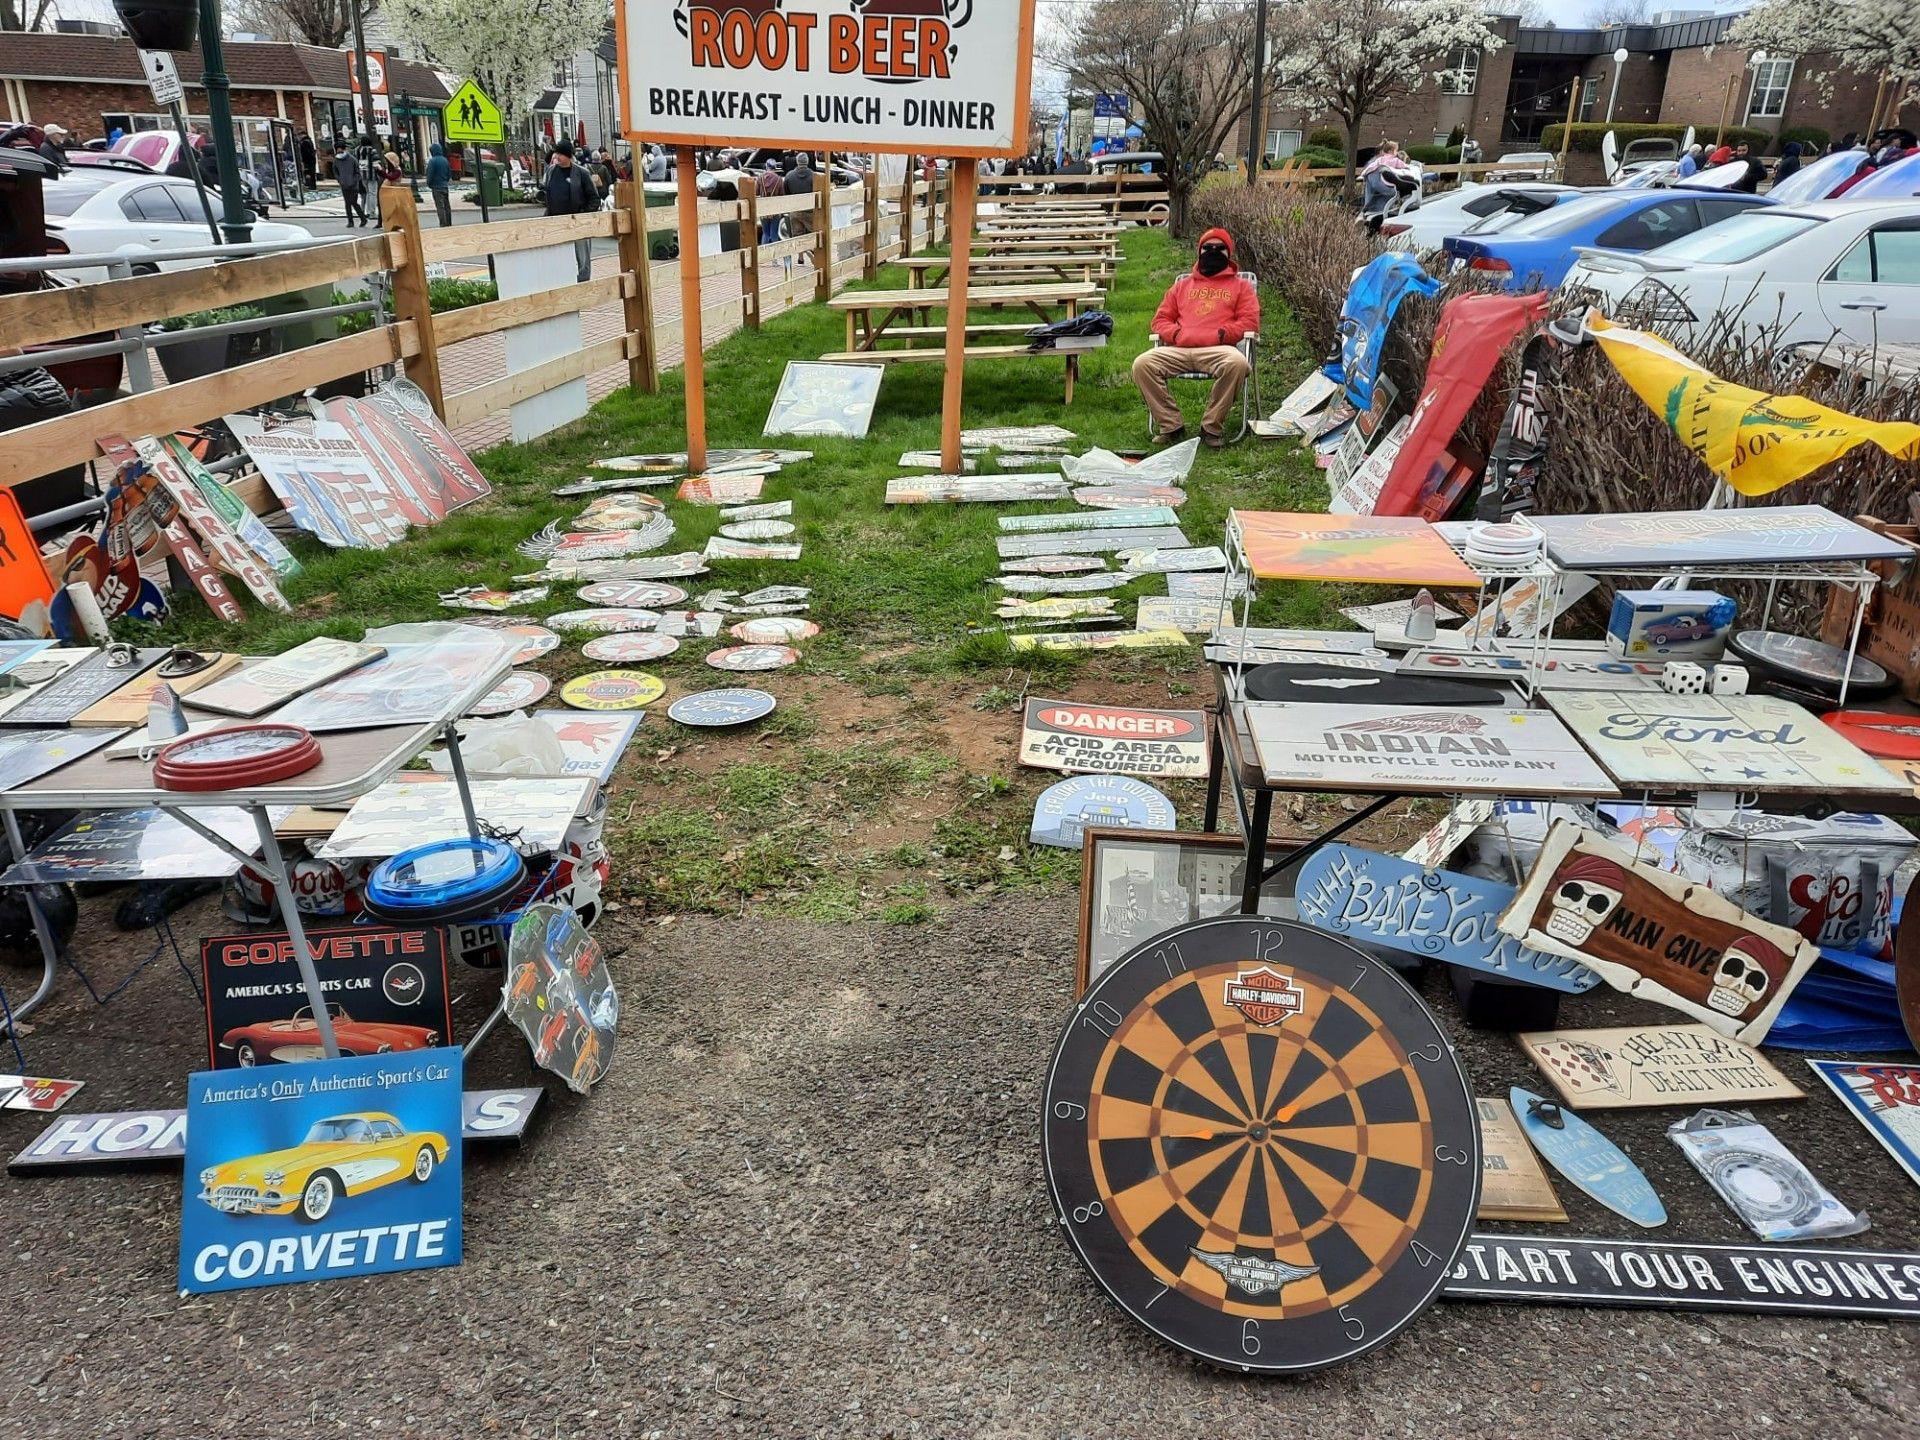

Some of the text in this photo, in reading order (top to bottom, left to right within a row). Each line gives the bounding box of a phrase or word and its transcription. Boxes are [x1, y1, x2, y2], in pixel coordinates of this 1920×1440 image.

[689, 7, 951, 79] ROOT BEER
[649, 87, 996, 130] BREAKFAST LUNCH DINNER
[244, 435, 357, 450] AMERICA'S BEER
[590, 583, 672, 601] STP
[1226, 650, 1382, 669] SPEED SHOP
[589, 672, 652, 683] WE USE
[581, 699, 638, 708] PARTS
[715, 715, 741, 723] LAST
[1054, 710, 1175, 734] DANGER
[1600, 713, 1805, 745] Ford
[1029, 744, 1200, 764] EYE PROTECTION
[1045, 735, 1182, 754] ACID AREA
[1323, 732, 1511, 756] INDIAN
[1063, 757, 1164, 772] REQUIRED
[1295, 752, 1557, 771] MOTORCYCLE COMPANY
[1642, 746, 1822, 764] PARTS
[1371, 771, 1457, 783] Established
[1044, 777, 1168, 827] EXPLORE THE OUTDOORS
[1084, 792, 1129, 805] Jeep
[47, 843, 128, 852] TRUCKS
[1250, 929, 1284, 962] 12
[1606, 906, 1721, 976] MAN CAVE
[1154, 942, 1187, 979] 11
[226, 983, 293, 998] AMERICA'S
[345, 978, 372, 989] CAR
[1247, 976, 1285, 989] MOTOR
[1232, 989, 1297, 1006] HARLEY-DAVIDSON
[1083, 1000, 1123, 1038] 10
[1245, 1004, 1280, 1021] CYCLES
[1408, 1043, 1442, 1068] 2
[1620, 1031, 1753, 1066] CHEATERS
[1648, 1051, 1728, 1066] WILL BE
[202, 1064, 450, 1104] America's Only Authentic Sport's Car
[1641, 1069, 1714, 1092] DEALT
[1054, 1100, 1086, 1121] 9
[1435, 1144, 1468, 1166] 3
[1073, 1201, 1103, 1223] 8
[194, 1220, 449, 1283] CORVETTE
[1410, 1239, 1442, 1268] 4
[1231, 1266, 1276, 1281] HARLEY-DAVIDSON
[1242, 1258, 1266, 1269] MOTOR
[1592, 1250, 1724, 1292] YOUR
[1145, 1277, 1169, 1309] 7
[1240, 1280, 1264, 1292] CYCLES
[1338, 1305, 1365, 1341] 5
[1242, 1319, 1261, 1356] 6
